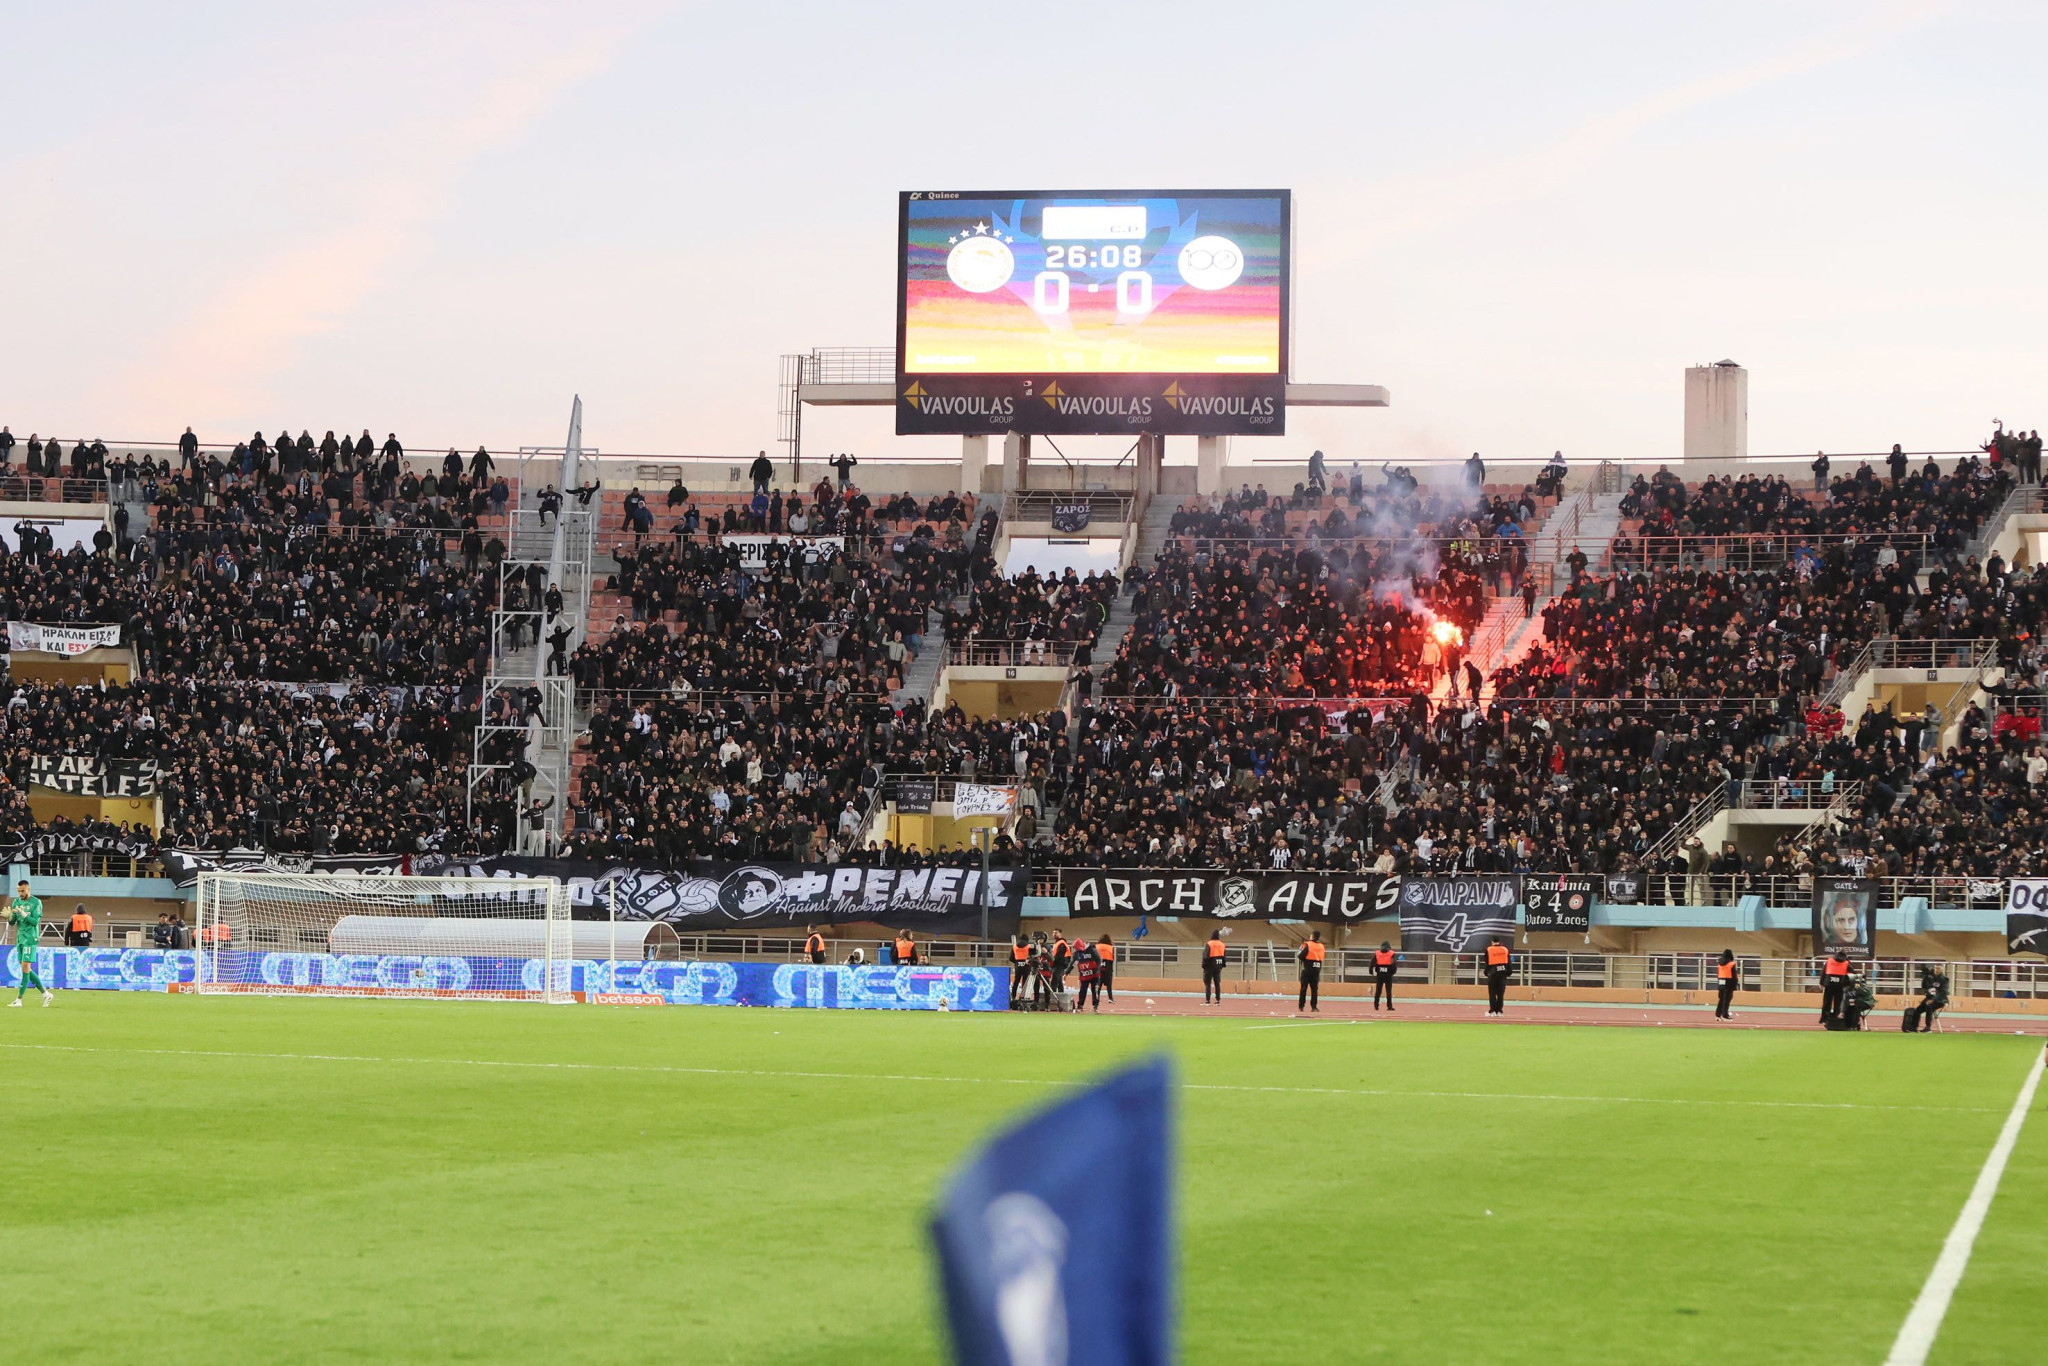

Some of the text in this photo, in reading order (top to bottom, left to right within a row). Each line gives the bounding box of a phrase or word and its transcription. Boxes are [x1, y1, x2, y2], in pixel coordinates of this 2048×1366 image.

[928, 191, 960, 200] Quince
[1045, 245, 1142, 268] 26:08
[1034, 271, 1070, 314] 0
[1117, 271, 1153, 314] 0
[920, 397, 1014, 415] VAVOULAS
[1057, 397, 1152, 415] VAVOULAS
[1178, 397, 1274, 415] VAVOULAS
[989, 415, 1014, 424] GROUP
[1127, 415, 1152, 424] GROUP
[1249, 415, 1274, 424] GROUP
[1055, 505, 1091, 514] ΖΑΡΟΣ
[42, 628, 86, 640] ΗΡΑΚΛΗ
[46, 641, 65, 652] ΚΑΙ
[1834, 882, 1852, 890] GATE
[1074, 877, 1205, 911] ARCH
[775, 893, 952, 920] Against Modern Football
[1547, 892, 1562, 912] 4
[1526, 913, 1588, 926] Vatos Locos
[1435, 913, 1470, 952] 4
[773, 963, 995, 1002] MEGA
[595, 993, 663, 1005] betsson
